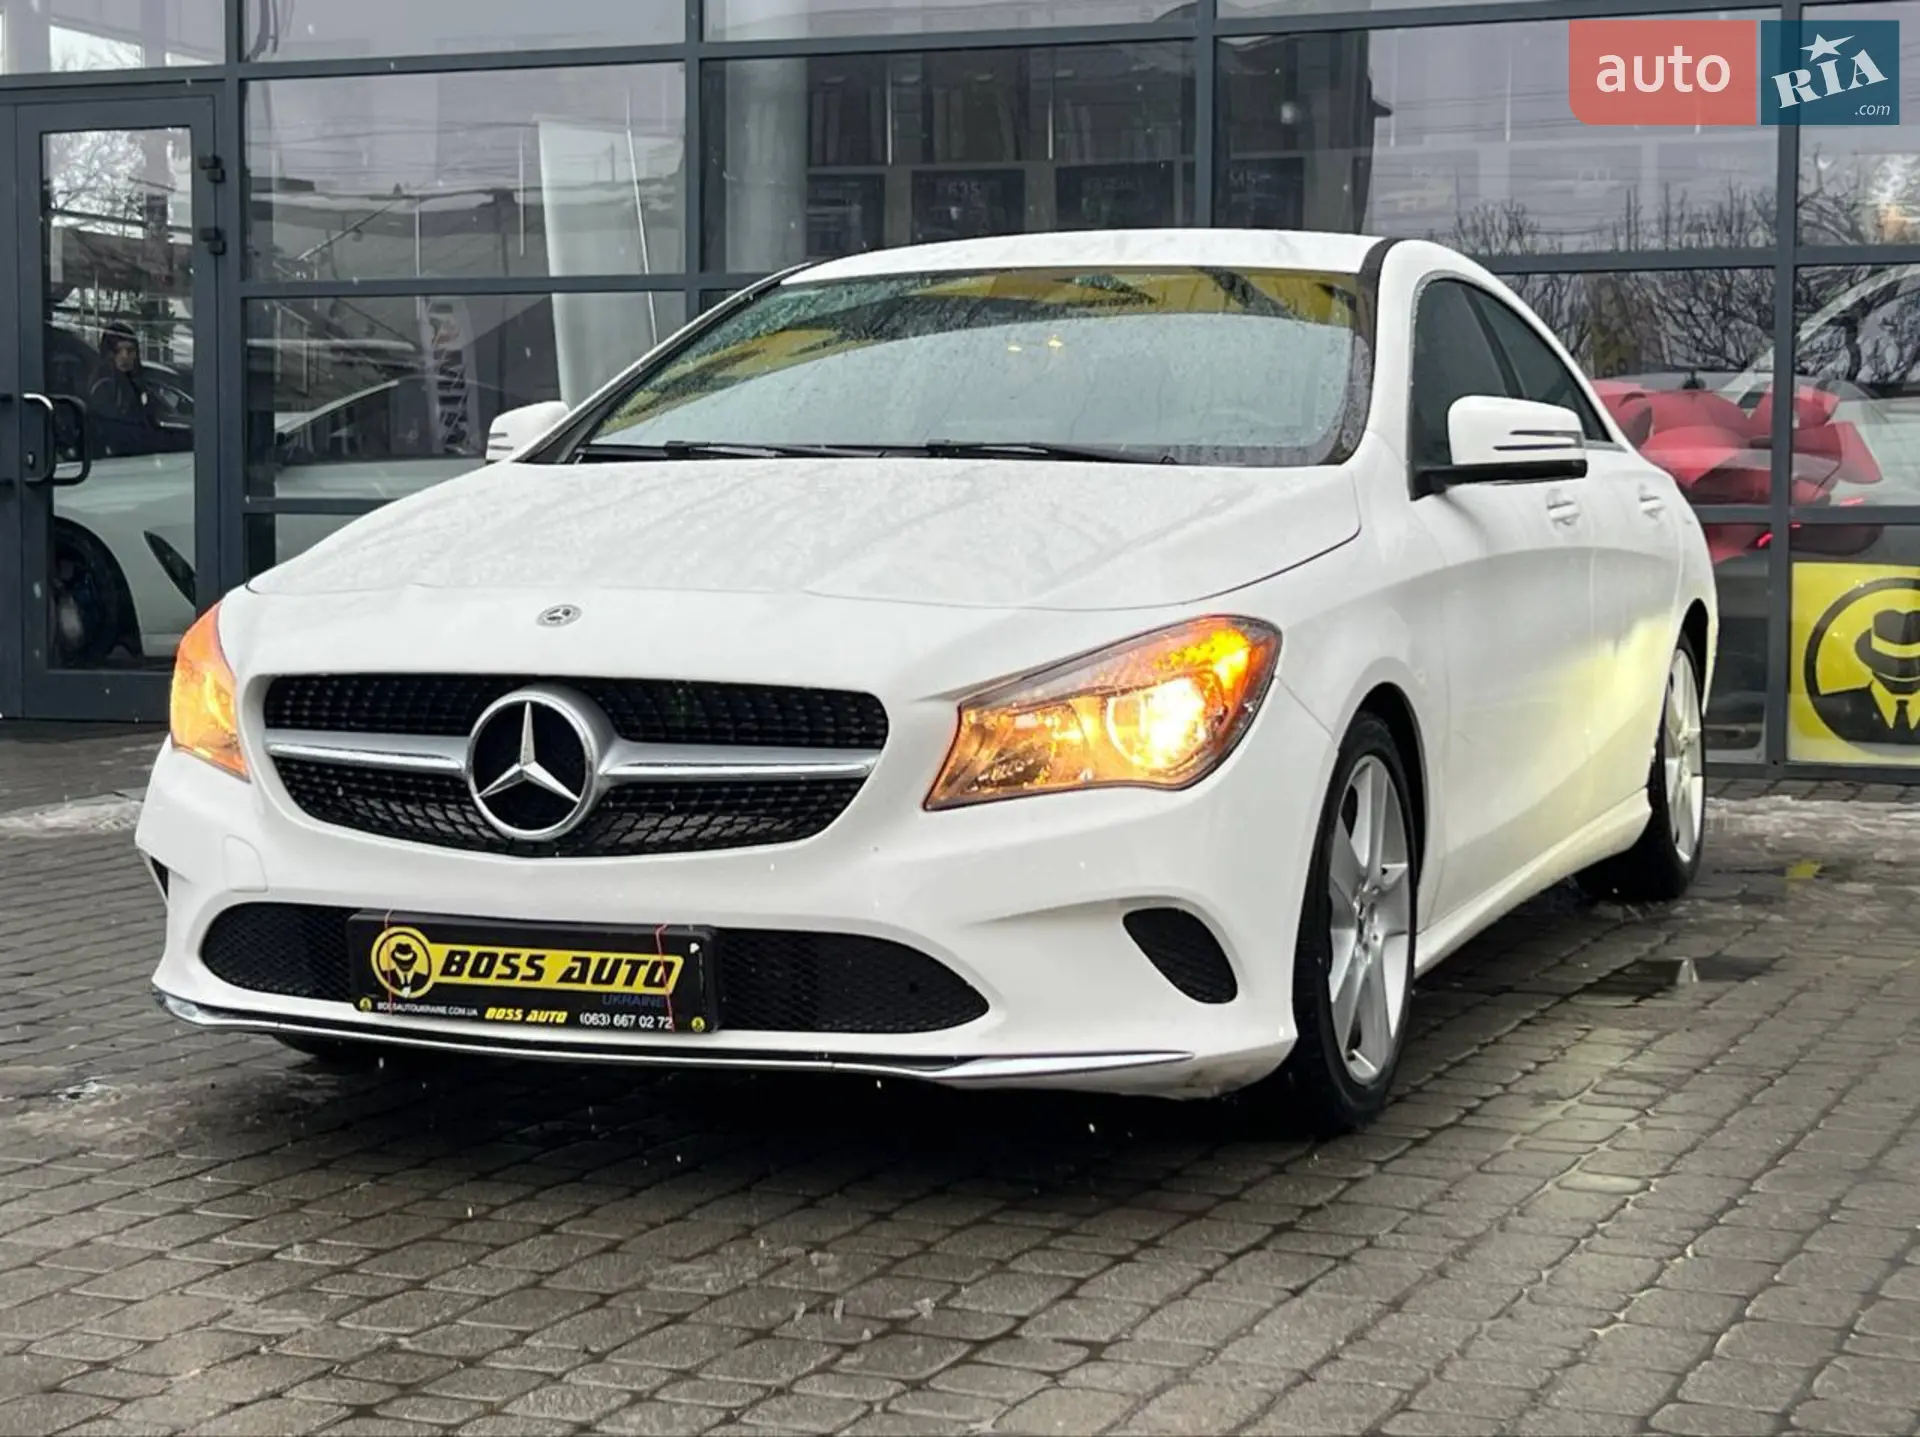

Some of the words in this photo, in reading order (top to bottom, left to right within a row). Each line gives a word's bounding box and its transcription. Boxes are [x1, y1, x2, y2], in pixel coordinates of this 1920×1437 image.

[439, 950, 547, 982] BOSS
[557, 956, 680, 989] AUTO
[601, 994, 665, 1008] UKRAINE
[484, 1006, 524, 1021] BOSS
[525, 1009, 569, 1024] AUTO
[579, 1012, 611, 1027] (063)
[613, 1013, 637, 1028] 667
[638, 1014, 655, 1029] 02
[656, 1016, 674, 1030] 72
